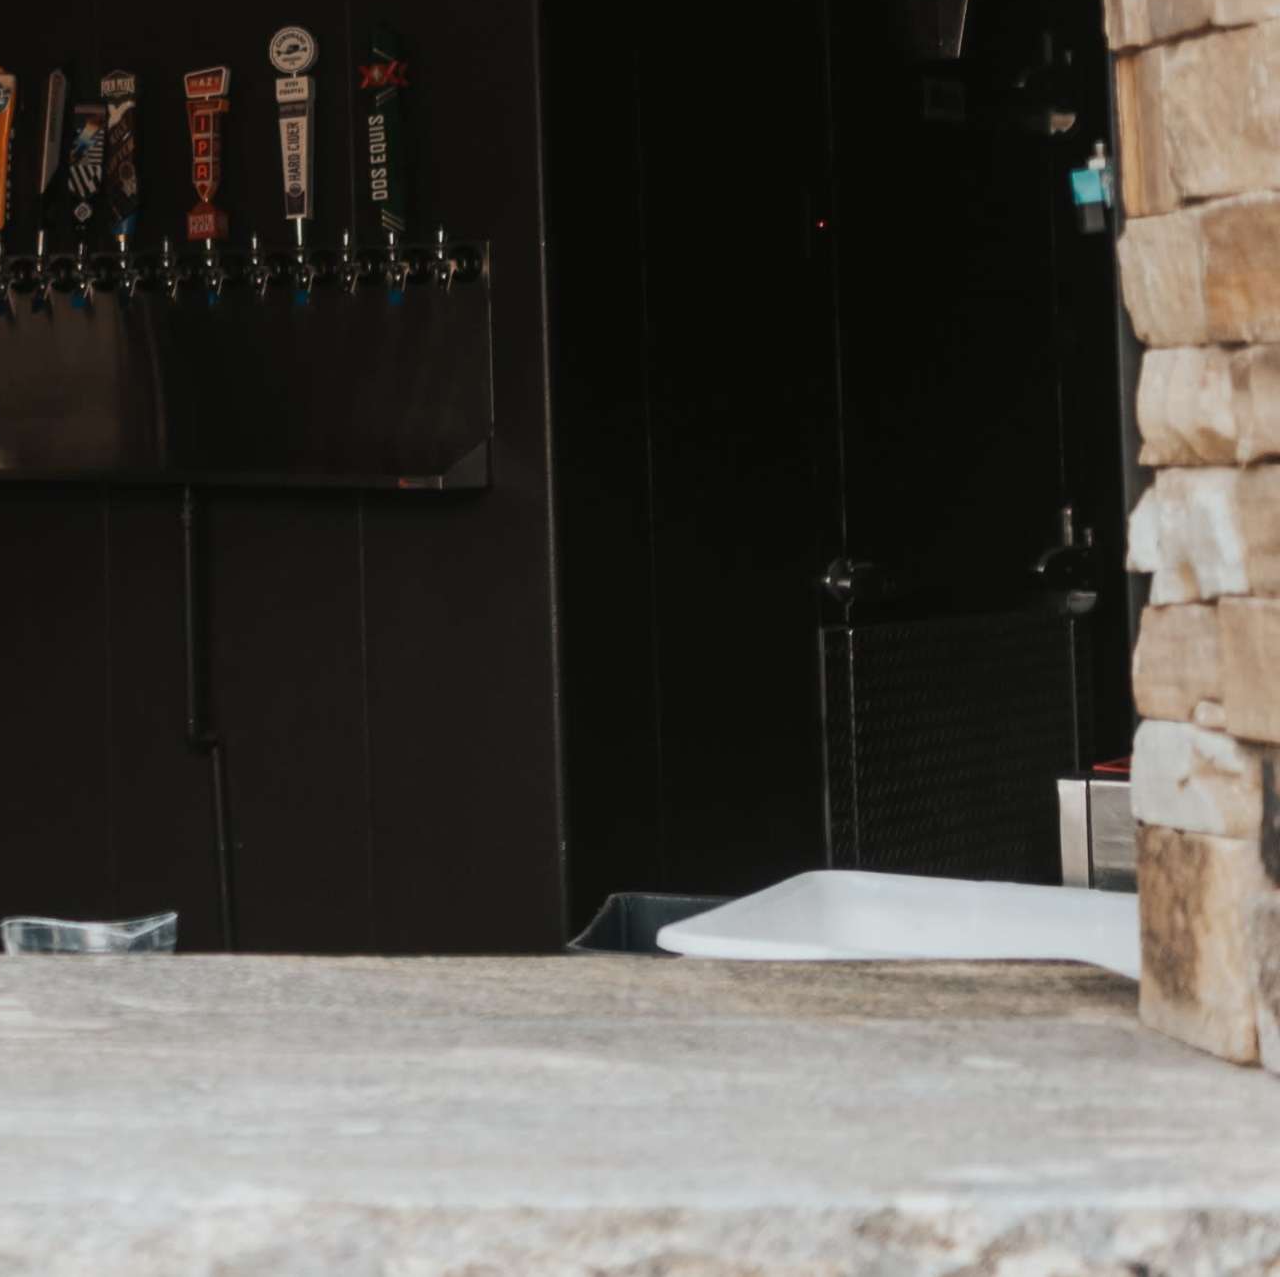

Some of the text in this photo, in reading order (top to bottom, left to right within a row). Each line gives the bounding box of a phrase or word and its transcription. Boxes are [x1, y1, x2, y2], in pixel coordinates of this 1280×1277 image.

[286, 122, 301, 182] HARD CIDER
[368, 114, 388, 201] DOS EQUIS
